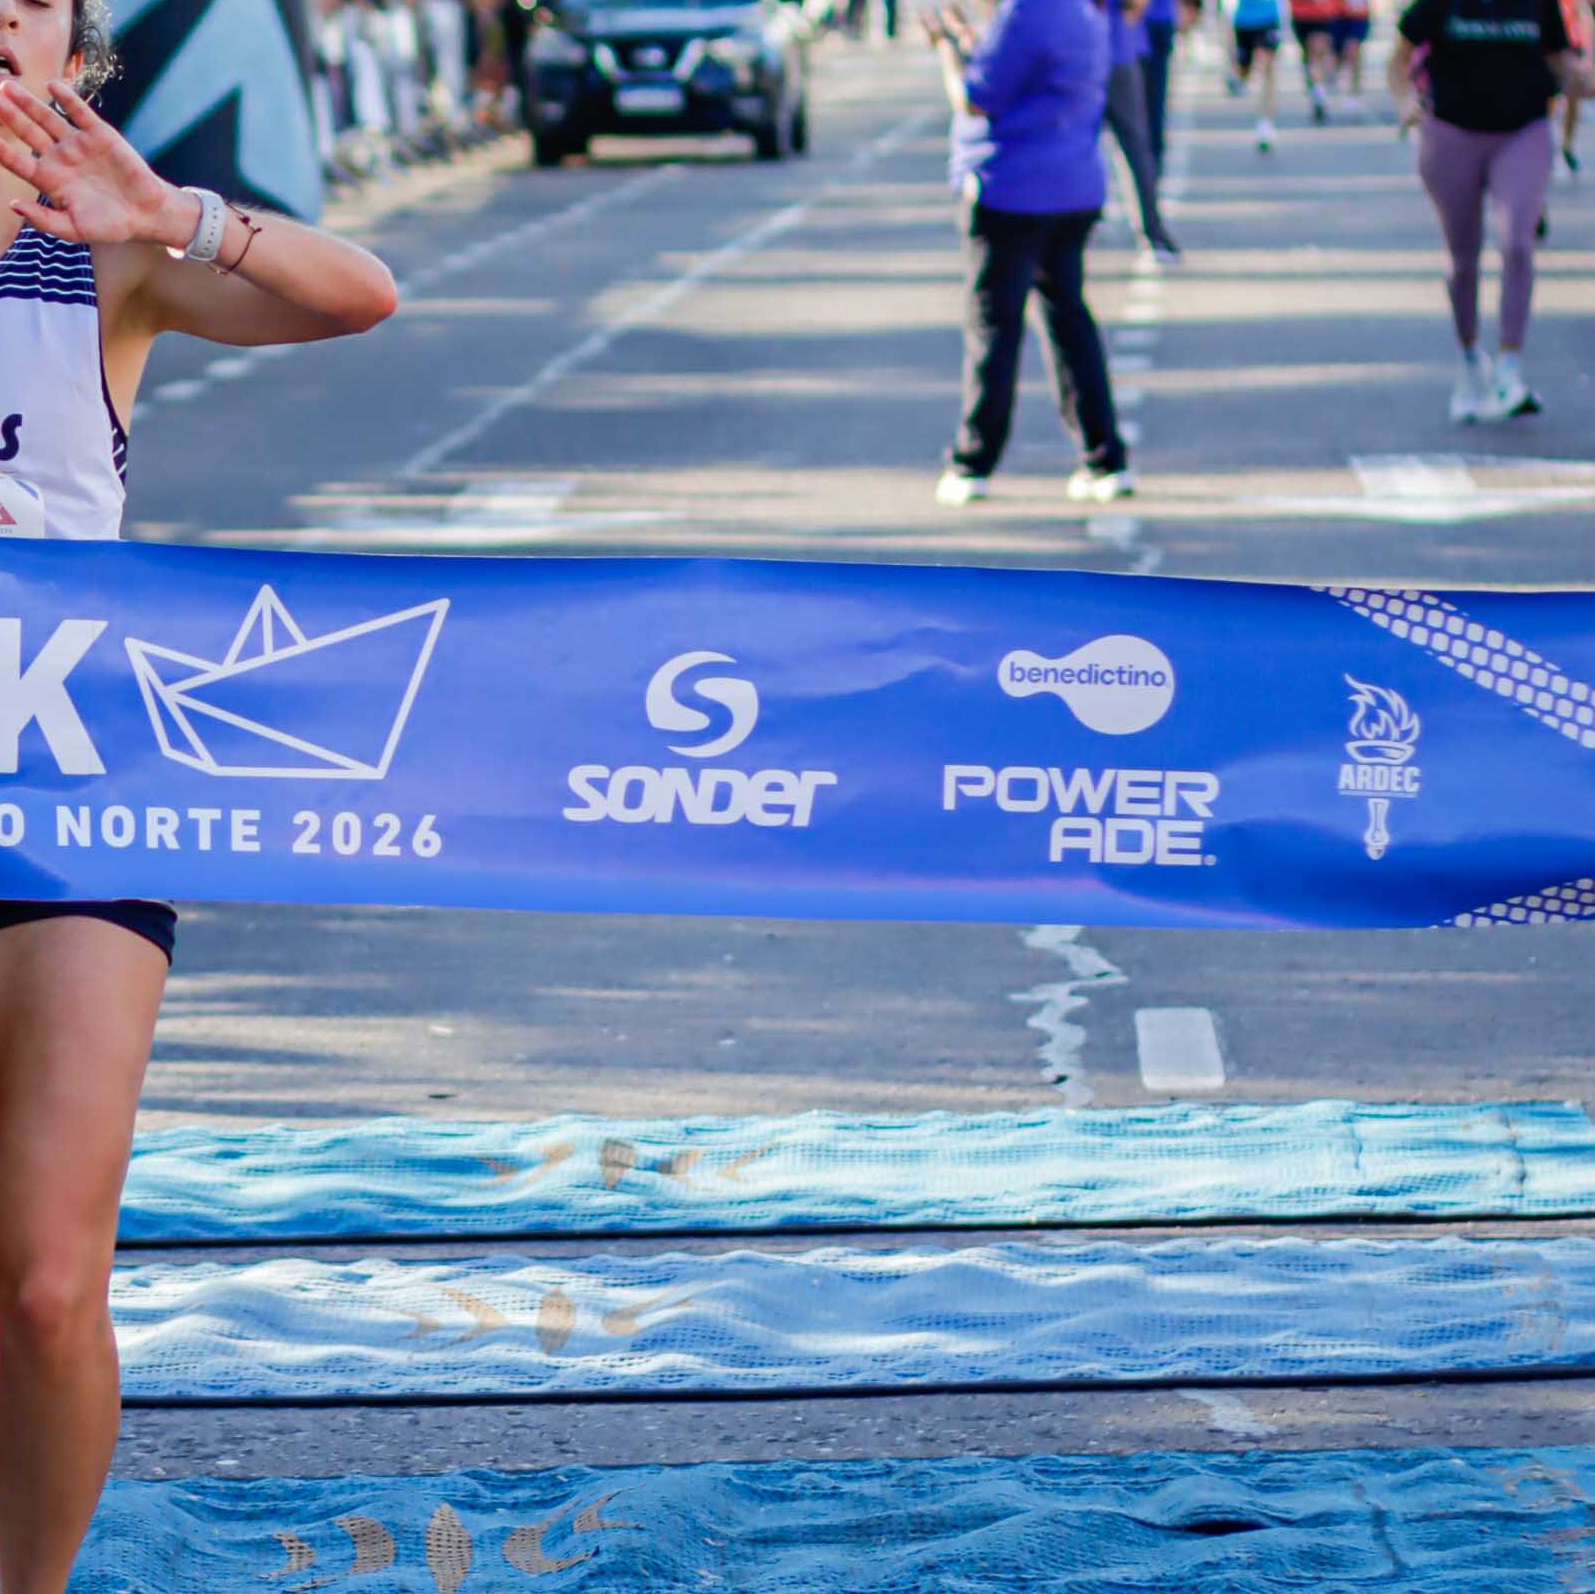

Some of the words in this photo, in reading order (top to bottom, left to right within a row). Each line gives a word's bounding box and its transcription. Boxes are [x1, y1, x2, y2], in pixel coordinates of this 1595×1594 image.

[1009, 661, 1167, 688] benedictino
[943, 765, 1220, 818] POWER
[1338, 763, 1421, 792] ARDEC
[56, 805, 261, 852] NORTE
[292, 811, 442, 858] 2026
